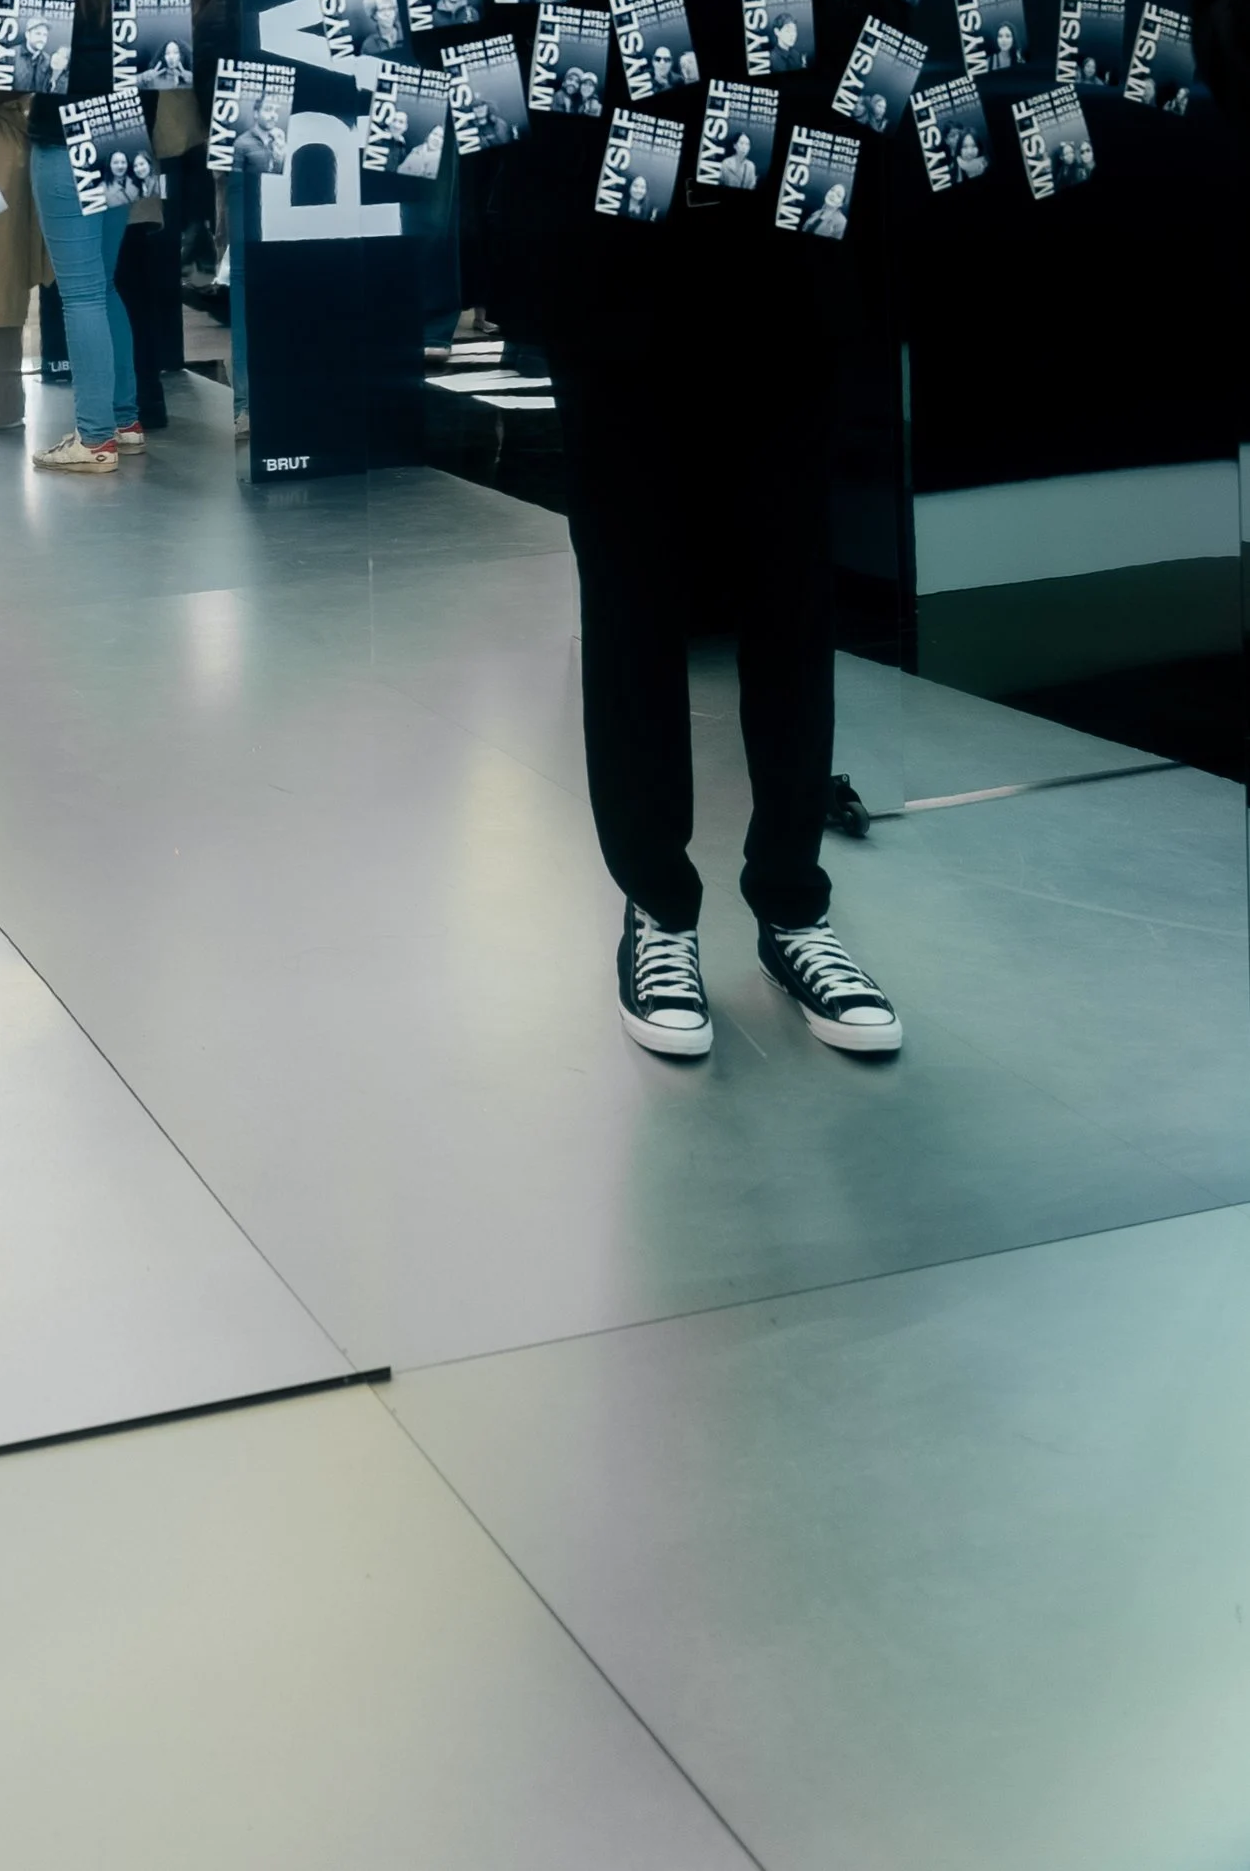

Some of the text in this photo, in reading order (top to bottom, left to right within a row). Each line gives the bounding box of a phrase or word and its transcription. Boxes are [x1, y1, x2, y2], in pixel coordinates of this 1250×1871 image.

[440, 46, 482, 155] MYSLF
[530, 4, 562, 112] MYSLF
[832, 15, 887, 118] MYSLF
[59, 101, 109, 216] MYSLF
[208, 59, 243, 171] MYSLF
[364, 62, 401, 172] MYSLF
[597, 108, 637, 216] MYSLF
[698, 80, 732, 186] MYSLF
[778, 126, 815, 231] MYSLF
